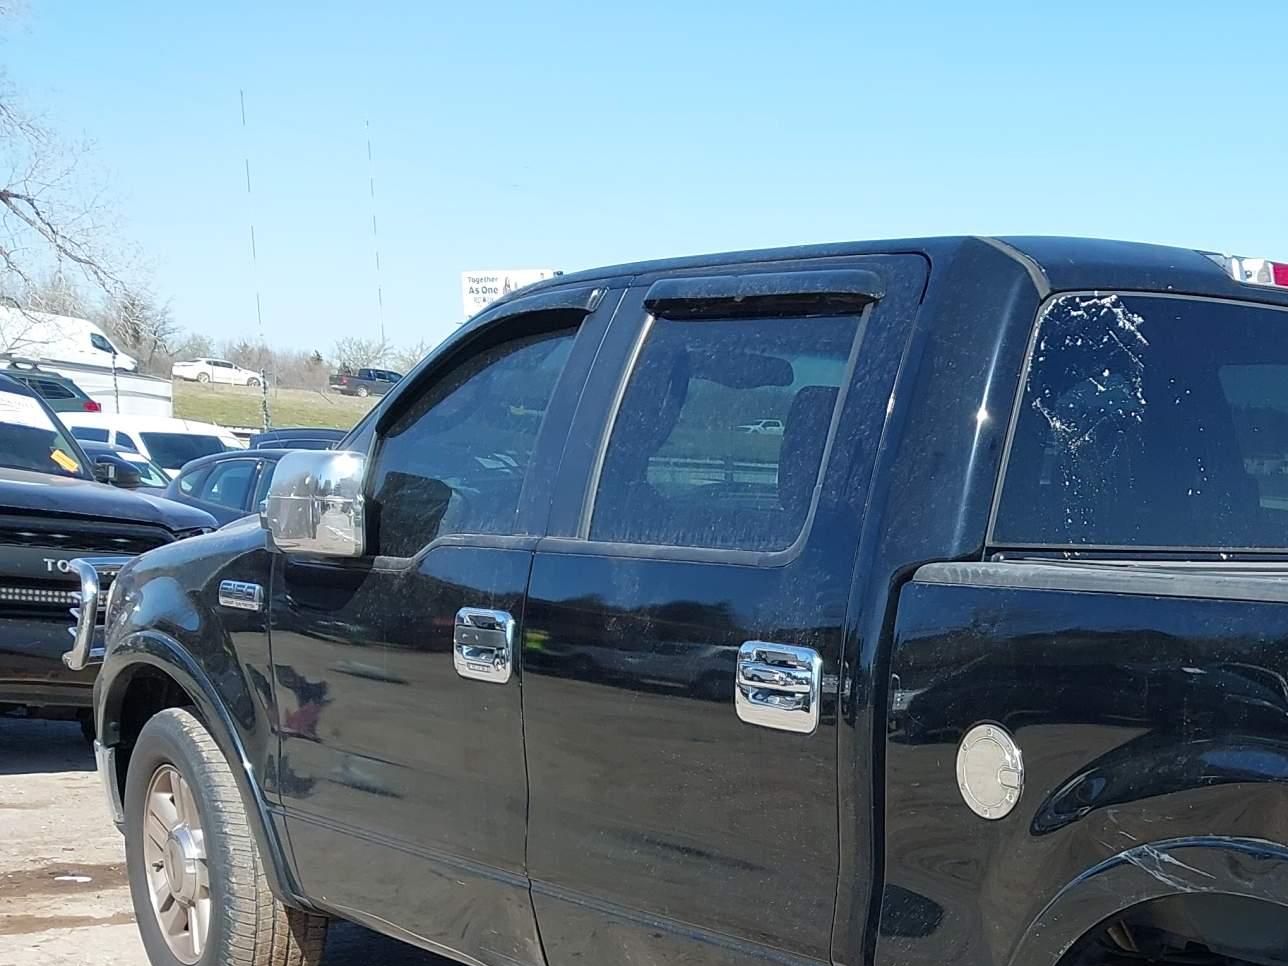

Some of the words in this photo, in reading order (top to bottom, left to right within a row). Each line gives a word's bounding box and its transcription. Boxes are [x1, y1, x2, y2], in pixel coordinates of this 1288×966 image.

[467, 276, 497, 284] Together
[468, 286, 480, 294] As
[481, 286, 498, 294] One
